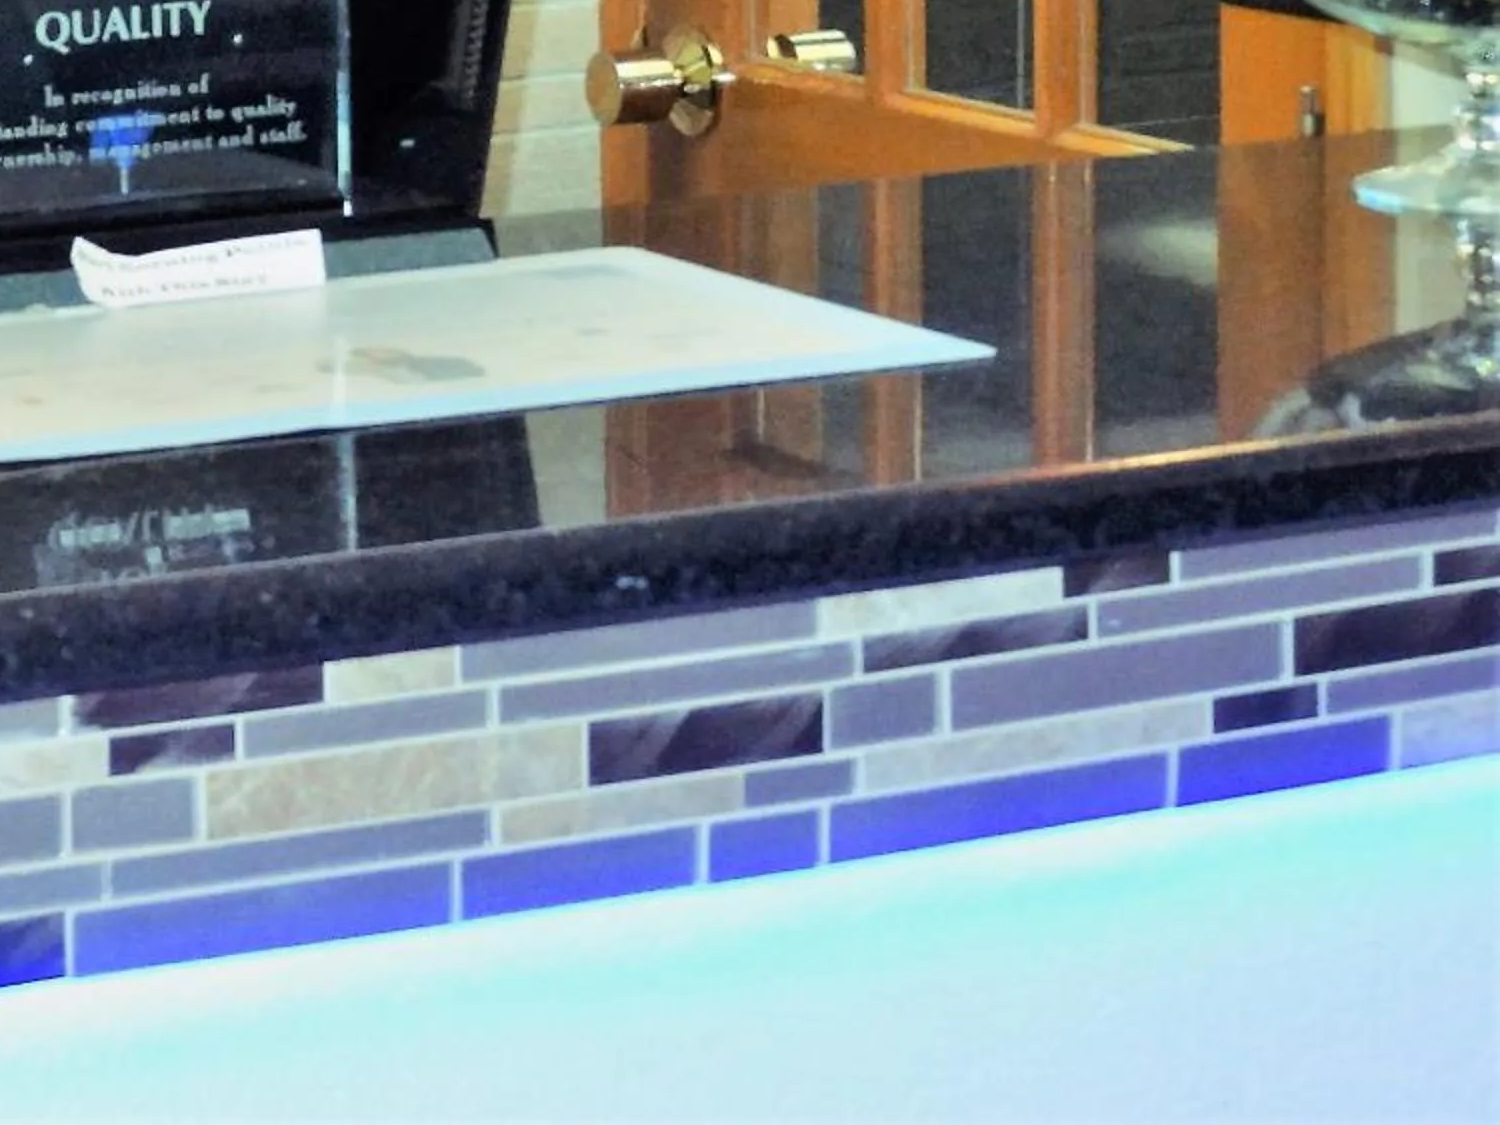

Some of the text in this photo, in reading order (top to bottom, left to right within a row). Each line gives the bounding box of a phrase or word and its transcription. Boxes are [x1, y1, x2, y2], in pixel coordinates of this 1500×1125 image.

[35, 0, 212, 54] QUALITY
[43, 72, 210, 107] In recognition of
[75, 107, 200, 133] commitment
[205, 105, 225, 121] to
[231, 93, 297, 123] quality
[218, 124, 255, 149] and
